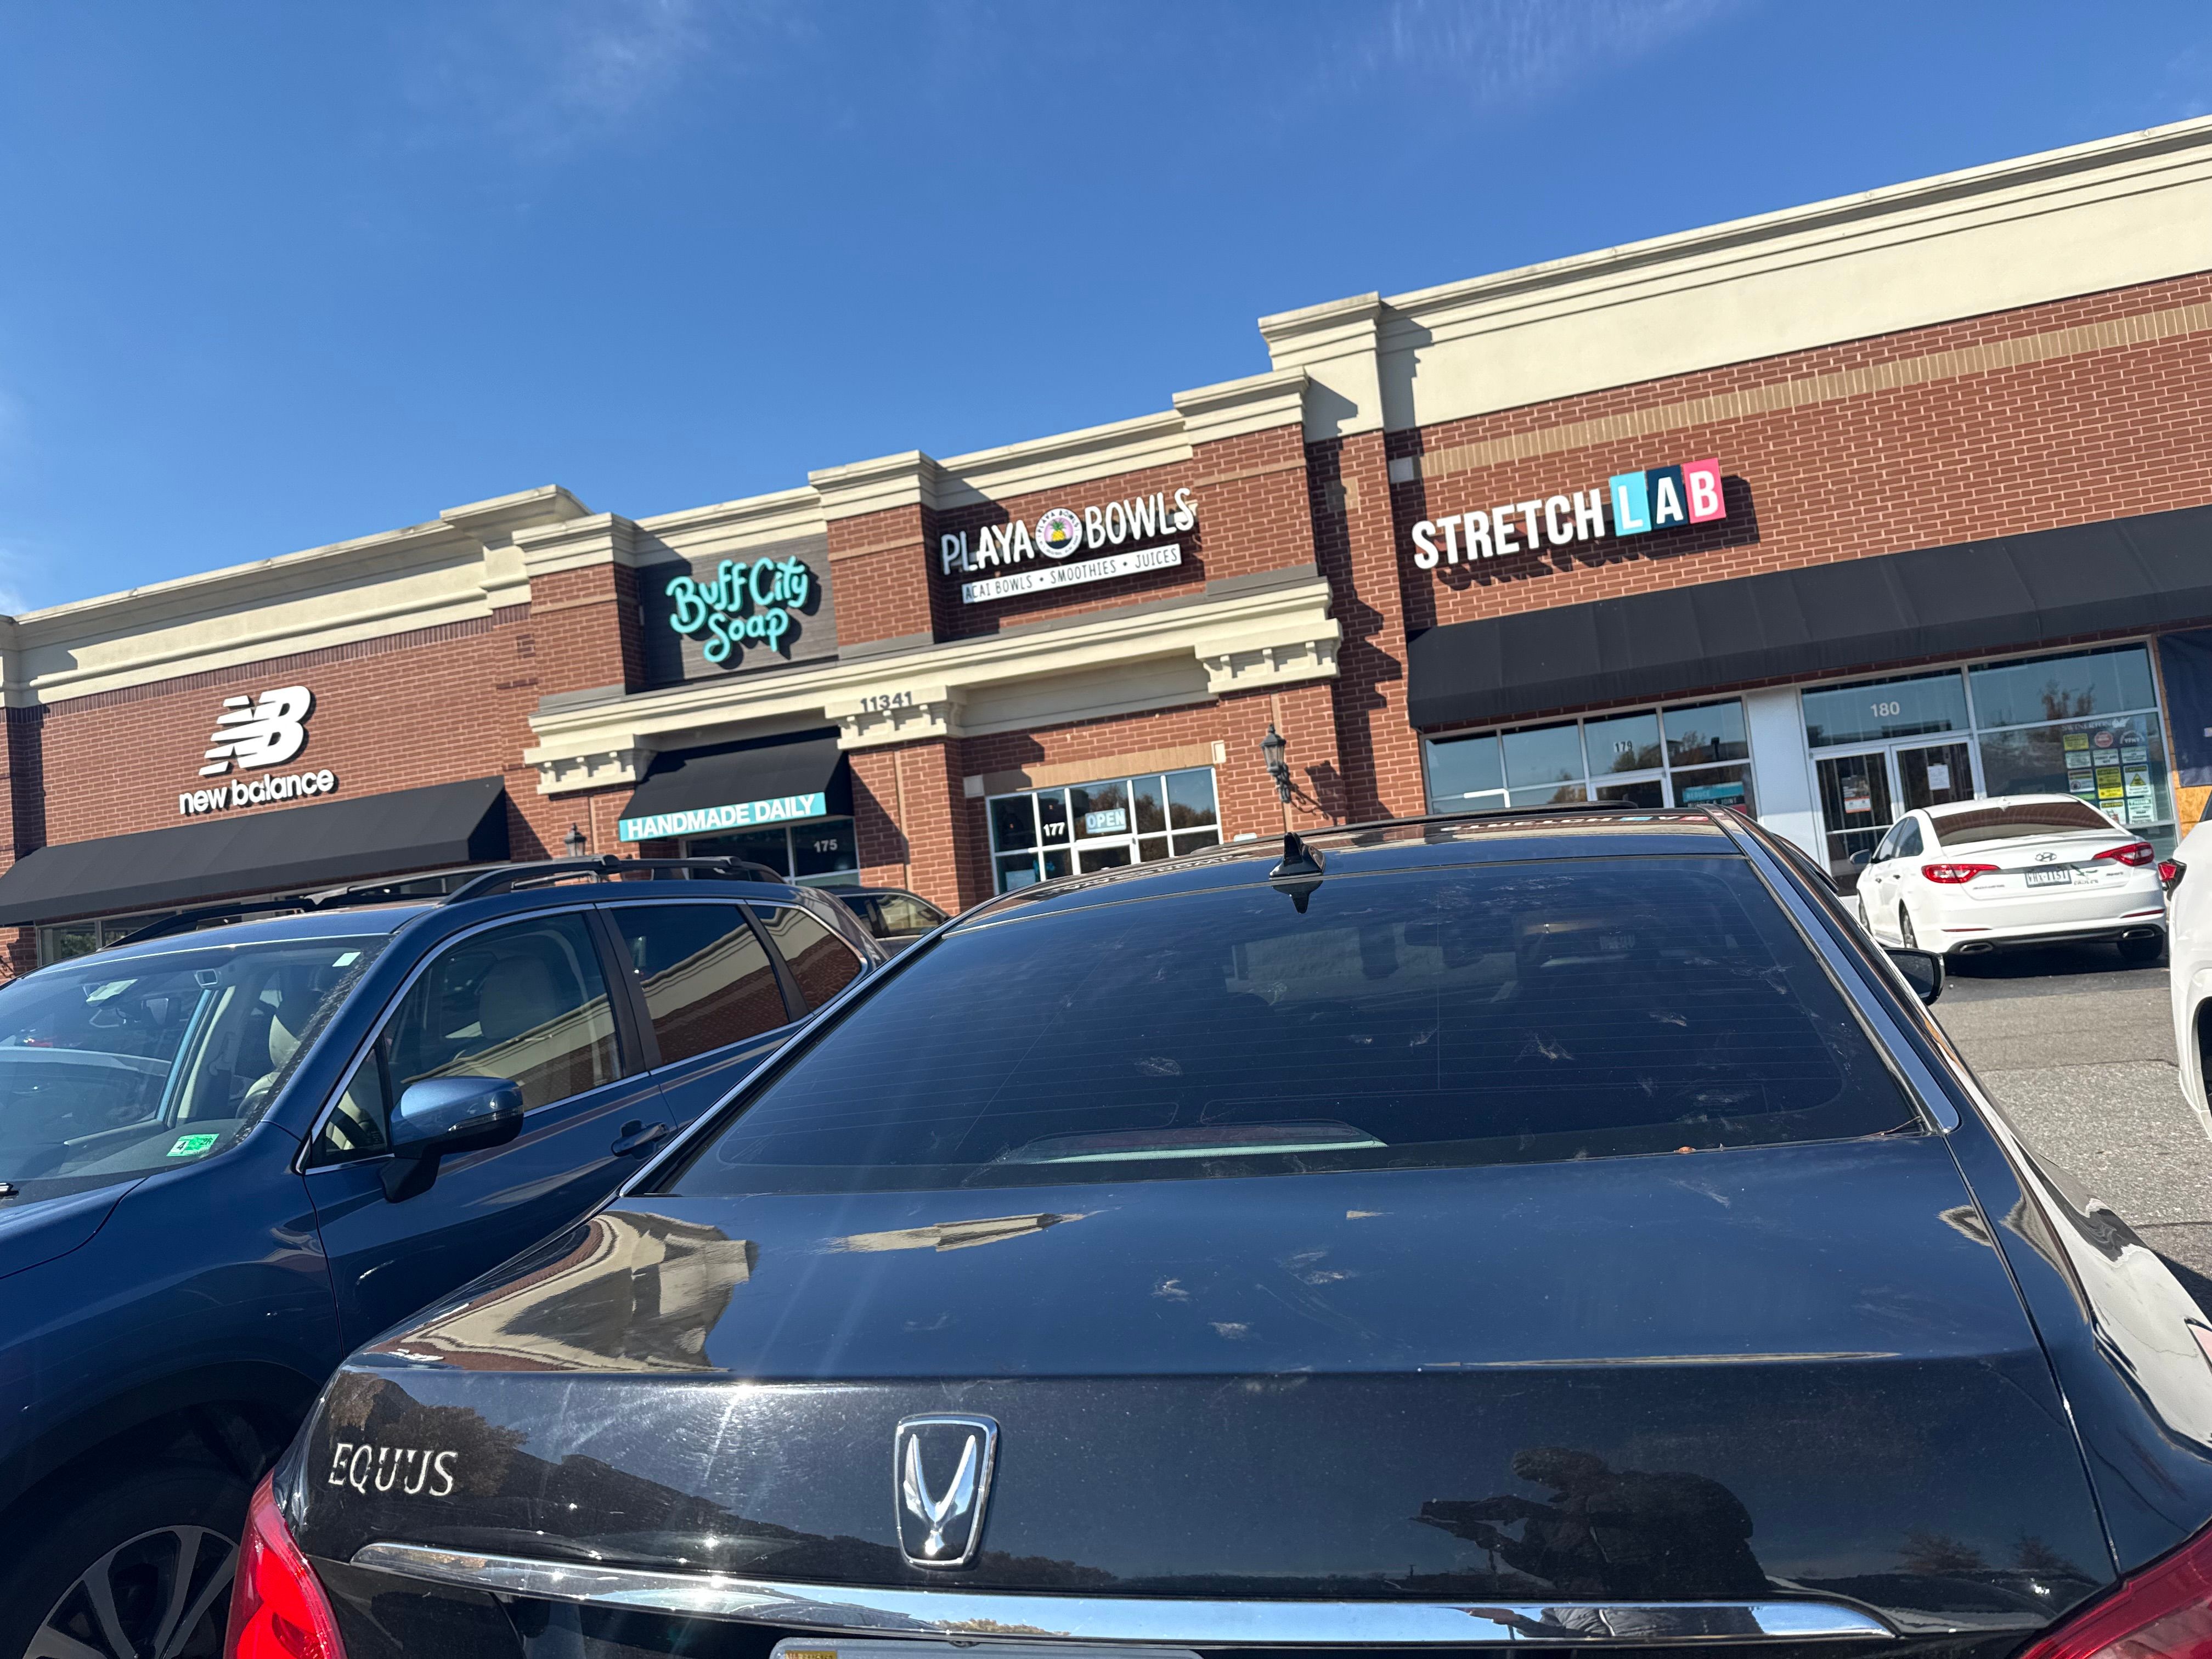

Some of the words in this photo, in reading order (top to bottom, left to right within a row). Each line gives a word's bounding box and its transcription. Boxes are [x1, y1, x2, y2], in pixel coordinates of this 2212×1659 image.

[941, 519, 1035, 575] PLAYA
[1084, 487, 1195, 549] BOWLS
[1411, 489, 1605, 569] STRETCH
[1616, 470, 1718, 531] LAB
[665, 558, 749, 634] Buff
[748, 555, 809, 609] City
[966, 584, 991, 600] ACAI
[996, 574, 1032, 594] BOWLS
[1050, 559, 1116, 584] SMOOTHIES
[1135, 549, 1178, 569] JUICES
[702, 608, 789, 663] Soap
[860, 691, 913, 712] 11341
[1870, 701, 1900, 718] 180
[1614, 741, 1633, 753] 179
[179, 787, 227, 815] new
[232, 769, 335, 806] balance
[627, 804, 751, 839] HANDMADE
[754, 796, 815, 817] DAILY
[1043, 822, 1065, 837] 177
[1087, 811, 1126, 828] OPEN
[814, 839, 838, 853] 175
[177, 1141, 187, 1150] 4
[328, 1443, 459, 1496] EQUUS
